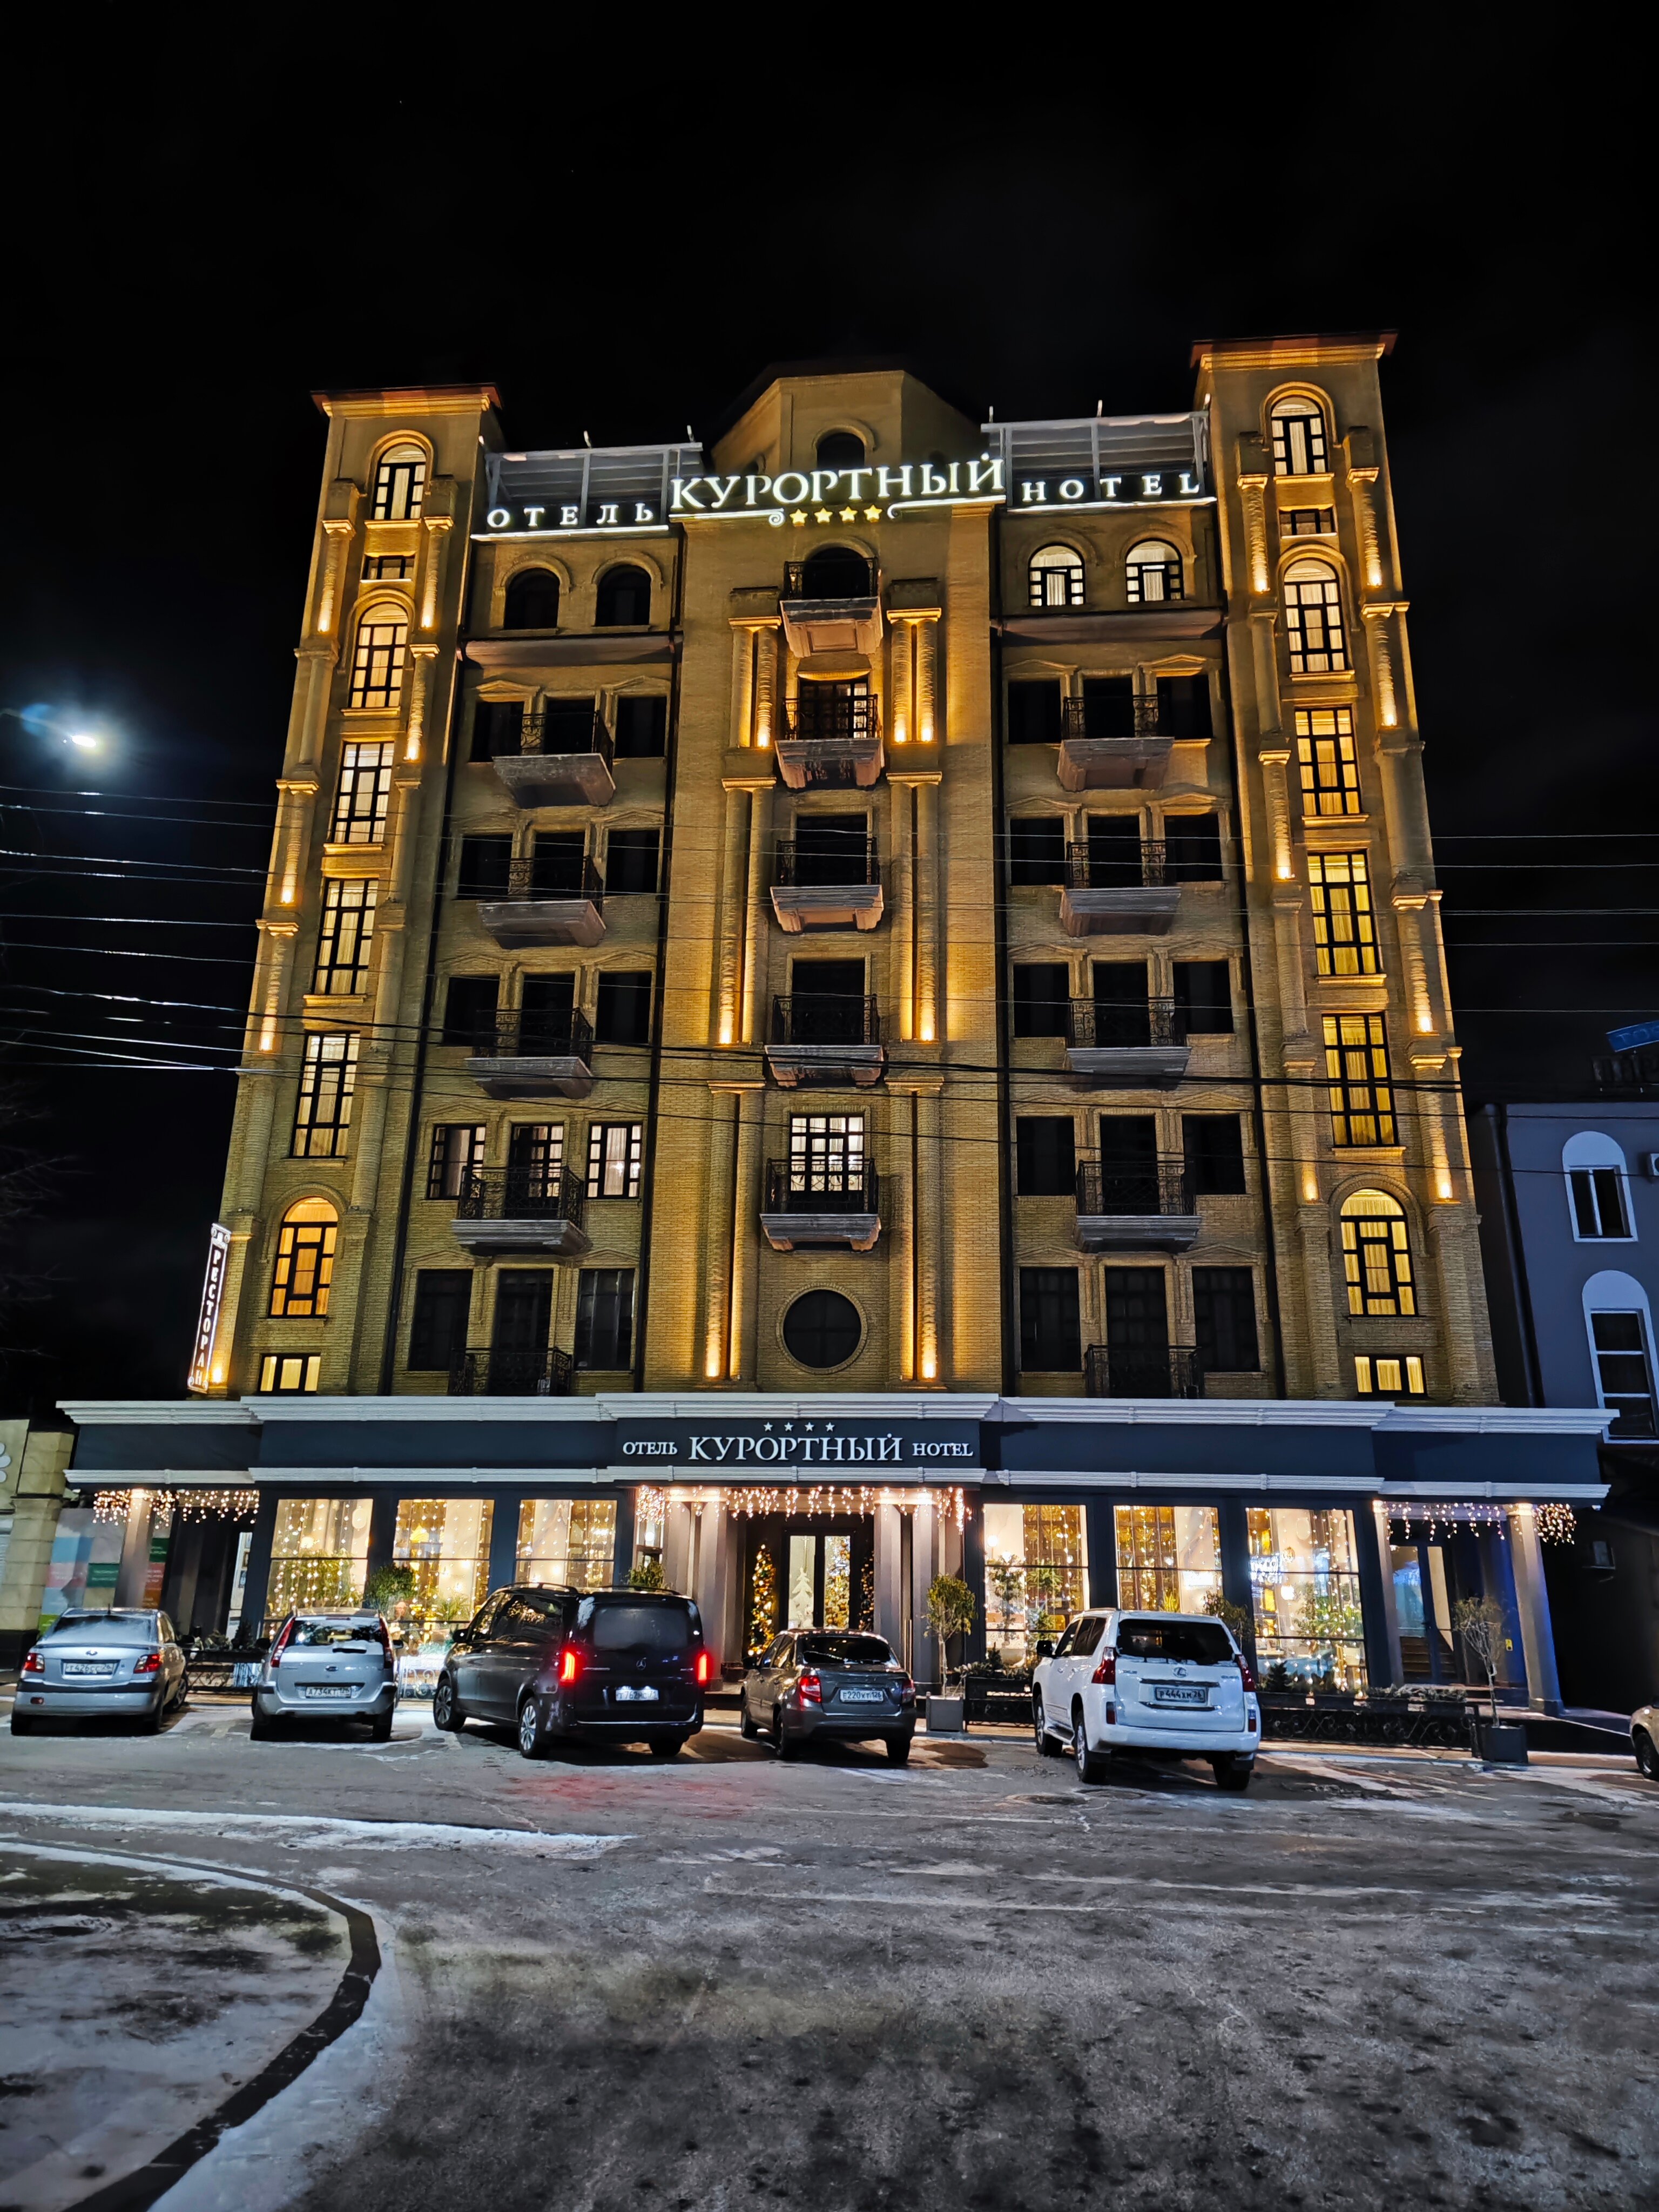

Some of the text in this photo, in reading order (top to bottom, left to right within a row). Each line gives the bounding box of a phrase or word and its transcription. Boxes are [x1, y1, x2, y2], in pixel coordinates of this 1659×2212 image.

[487, 453, 1201, 528] ОТЕЛЬ КУРОРТНЫЙ HOTEL
[195, 1249, 222, 1388] РЕСТОРАН
[622, 1433, 974, 1462] ОТЕЛЬ КУРОРТНЫЙ HOTEL
